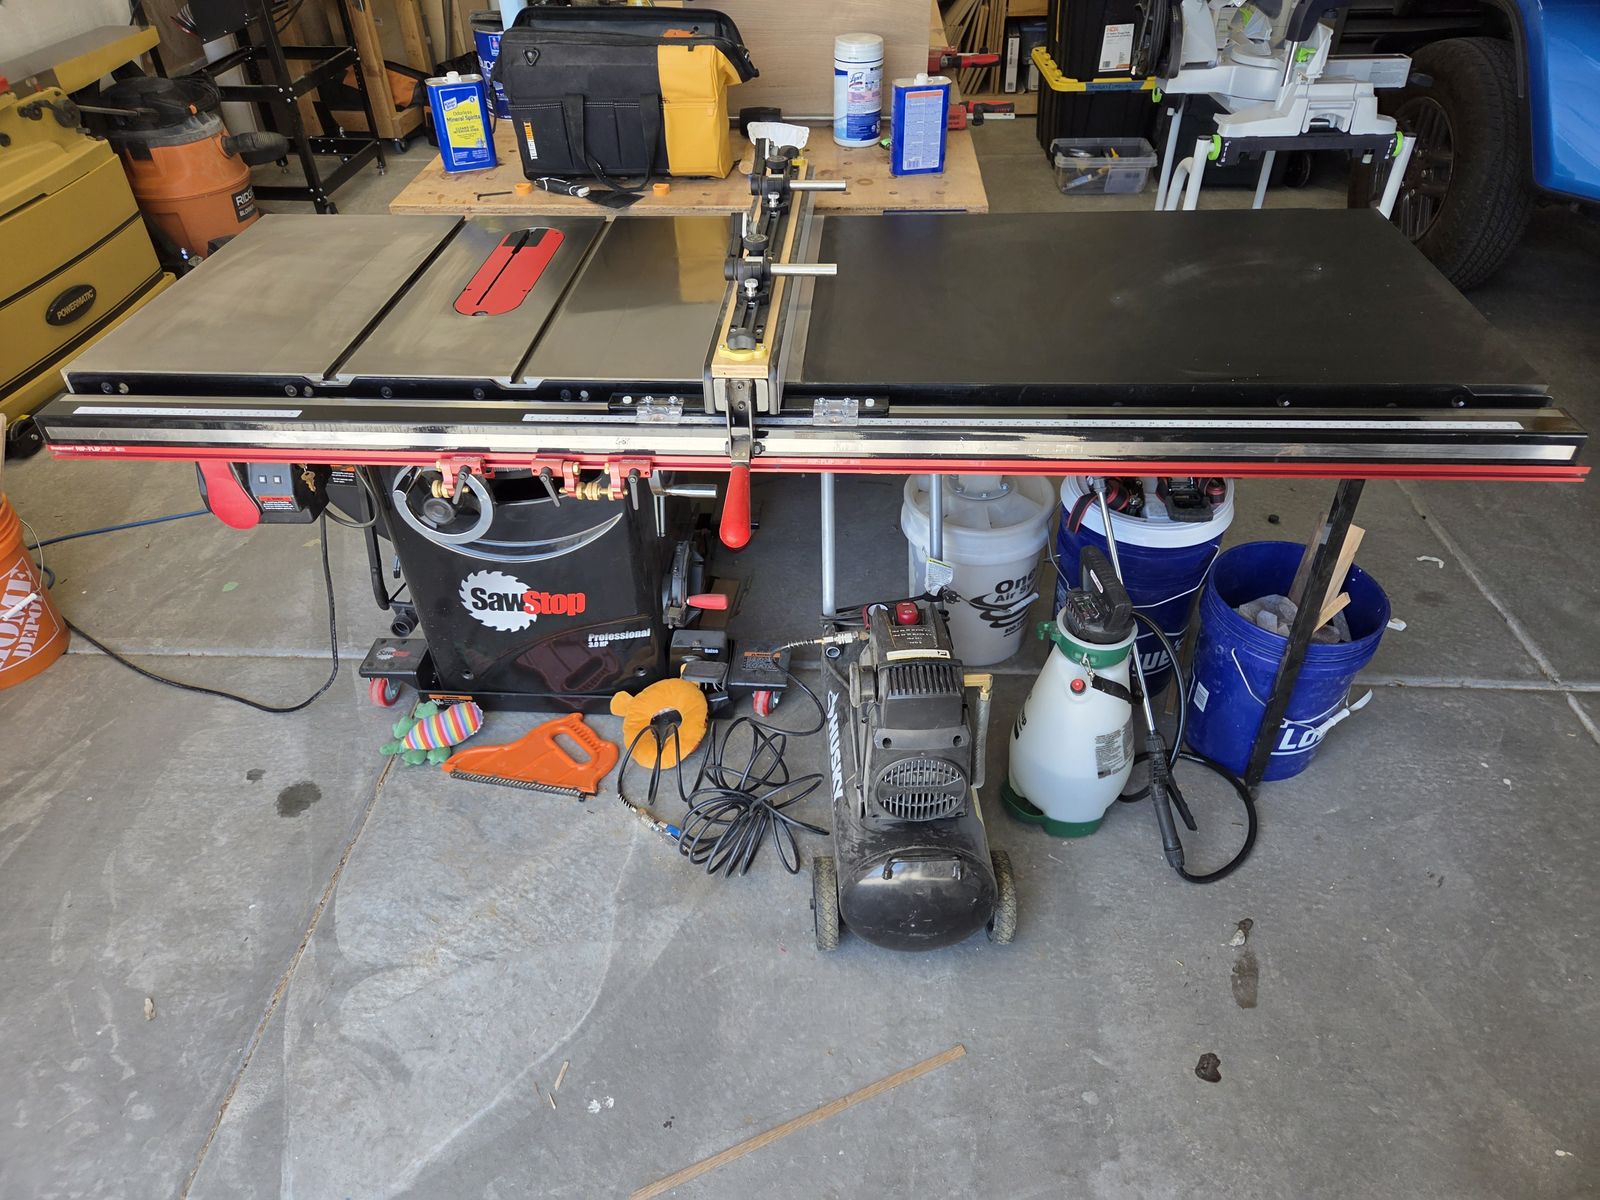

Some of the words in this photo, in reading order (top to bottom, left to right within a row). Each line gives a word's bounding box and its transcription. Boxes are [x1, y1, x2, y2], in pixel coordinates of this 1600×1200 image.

[465, 114, 480, 122] Spirits
[236, 187, 254, 206] RIDG
[56, 289, 94, 320] POWERMATIC
[470, 587, 586, 616] SawStop
[994, 592, 1015, 603] Air
[588, 628, 651, 642] Professional
[599, 640, 608, 648] HP
[827, 712, 844, 802] HUSKY
